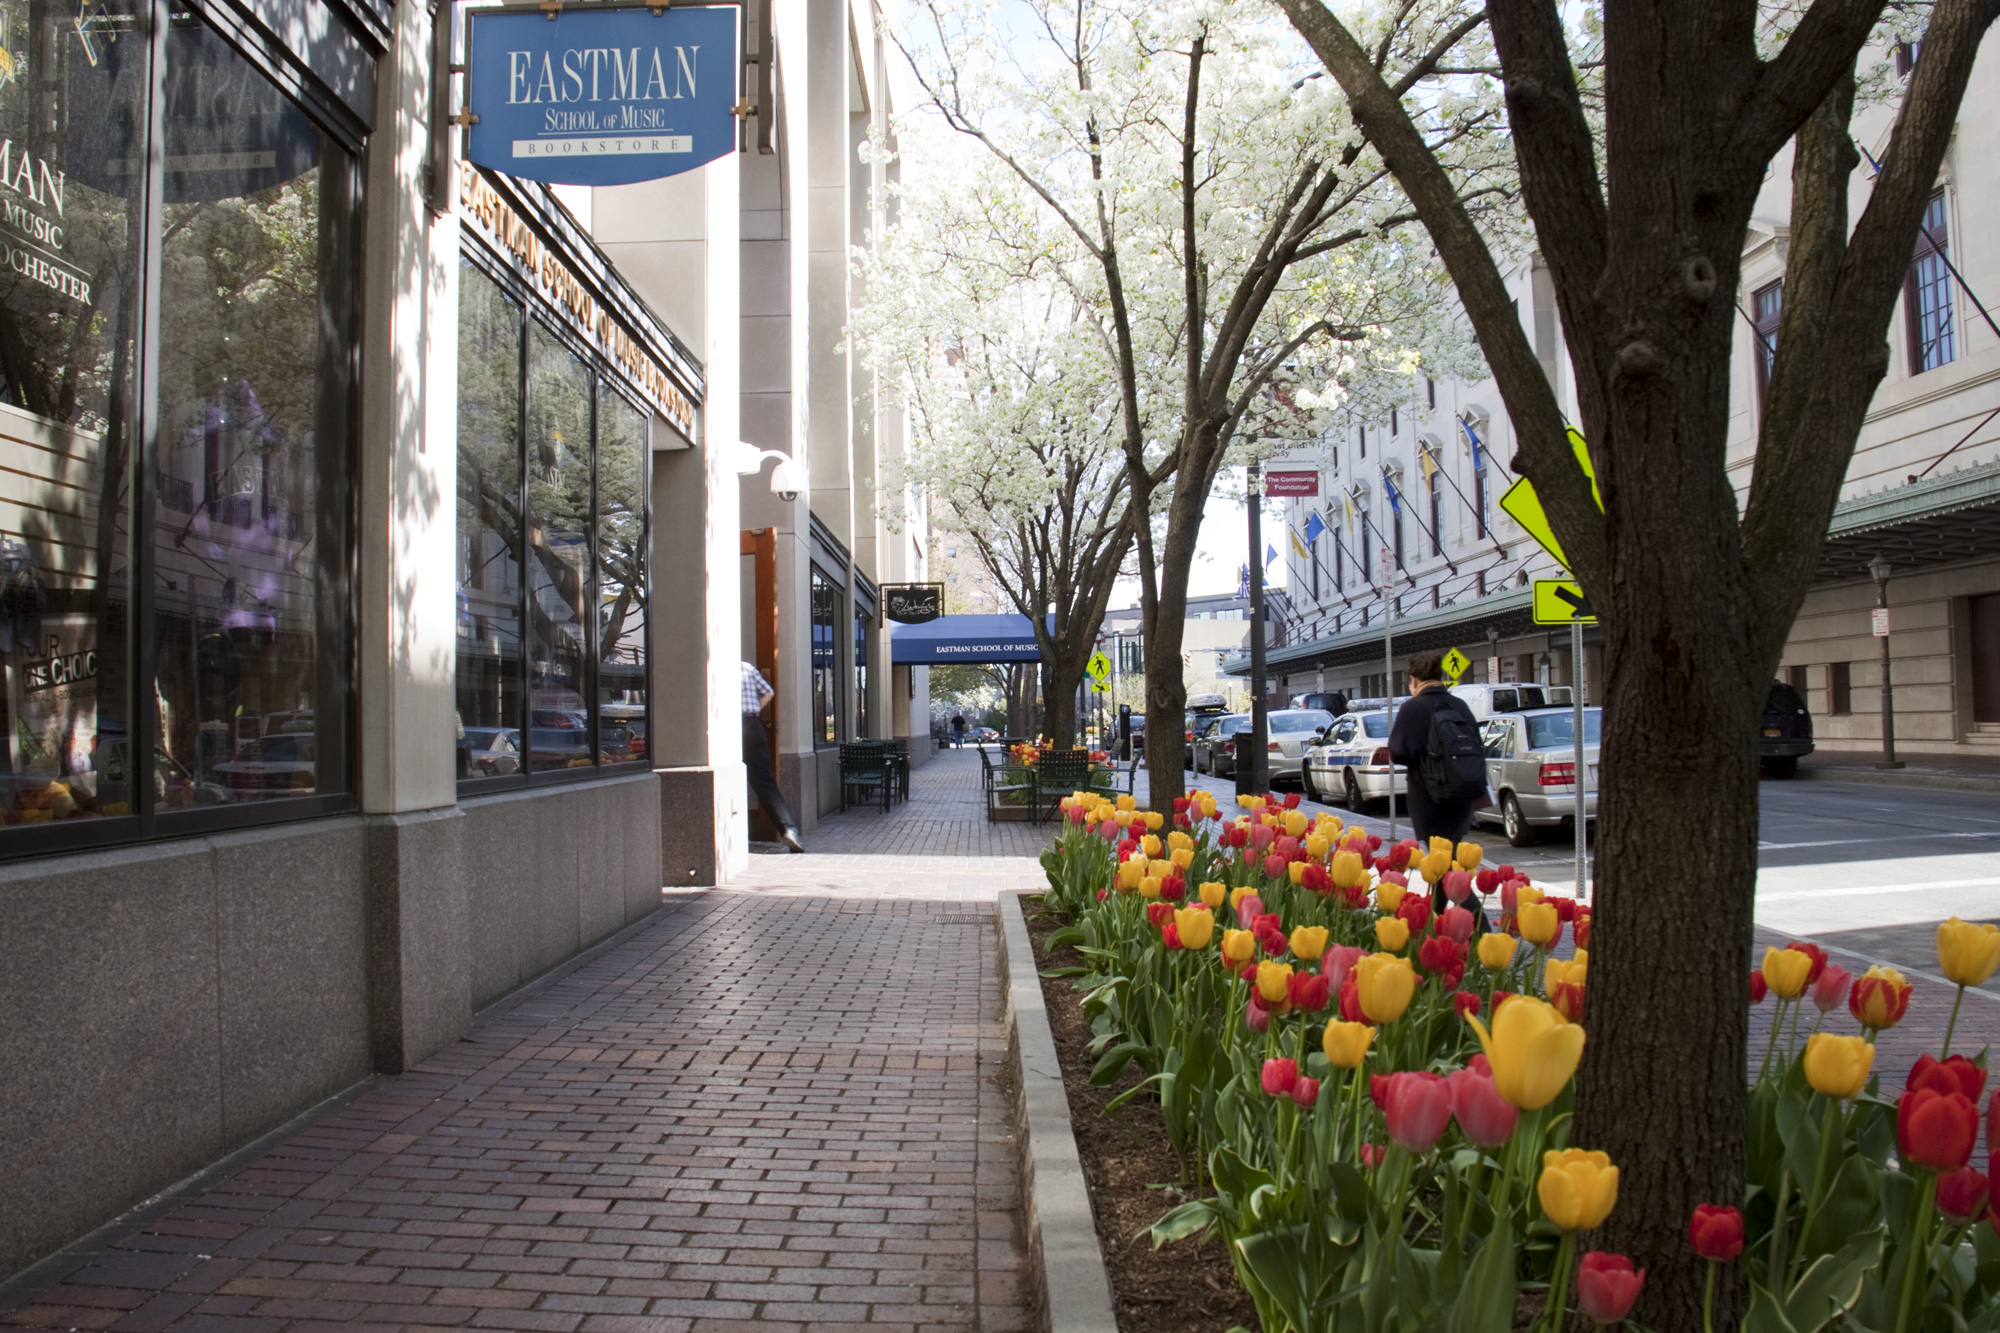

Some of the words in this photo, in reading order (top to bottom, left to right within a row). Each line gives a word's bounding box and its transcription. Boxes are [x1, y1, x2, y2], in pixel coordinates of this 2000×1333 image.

[505, 46, 701, 104] EASTMAN
[545, 108, 600, 132] SCHOOL
[620, 105, 665, 129] MUSIC
[528, 139, 679, 155] BOOKSTORE
[3, 199, 63, 250] MUSIC
[460, 160, 540, 274] EASTMAN
[543, 249, 594, 333] SCHOOL
[597, 309, 614, 347] OF
[615, 325, 645, 382] MUSIC
[646, 359, 692, 429] BOOKSTORE
[936, 645, 971, 653] EASTMAN
[971, 644, 1003, 652] SCHOOL
[1003, 644, 1013, 652] OF
[1015, 643, 1039, 651] MUSIC
